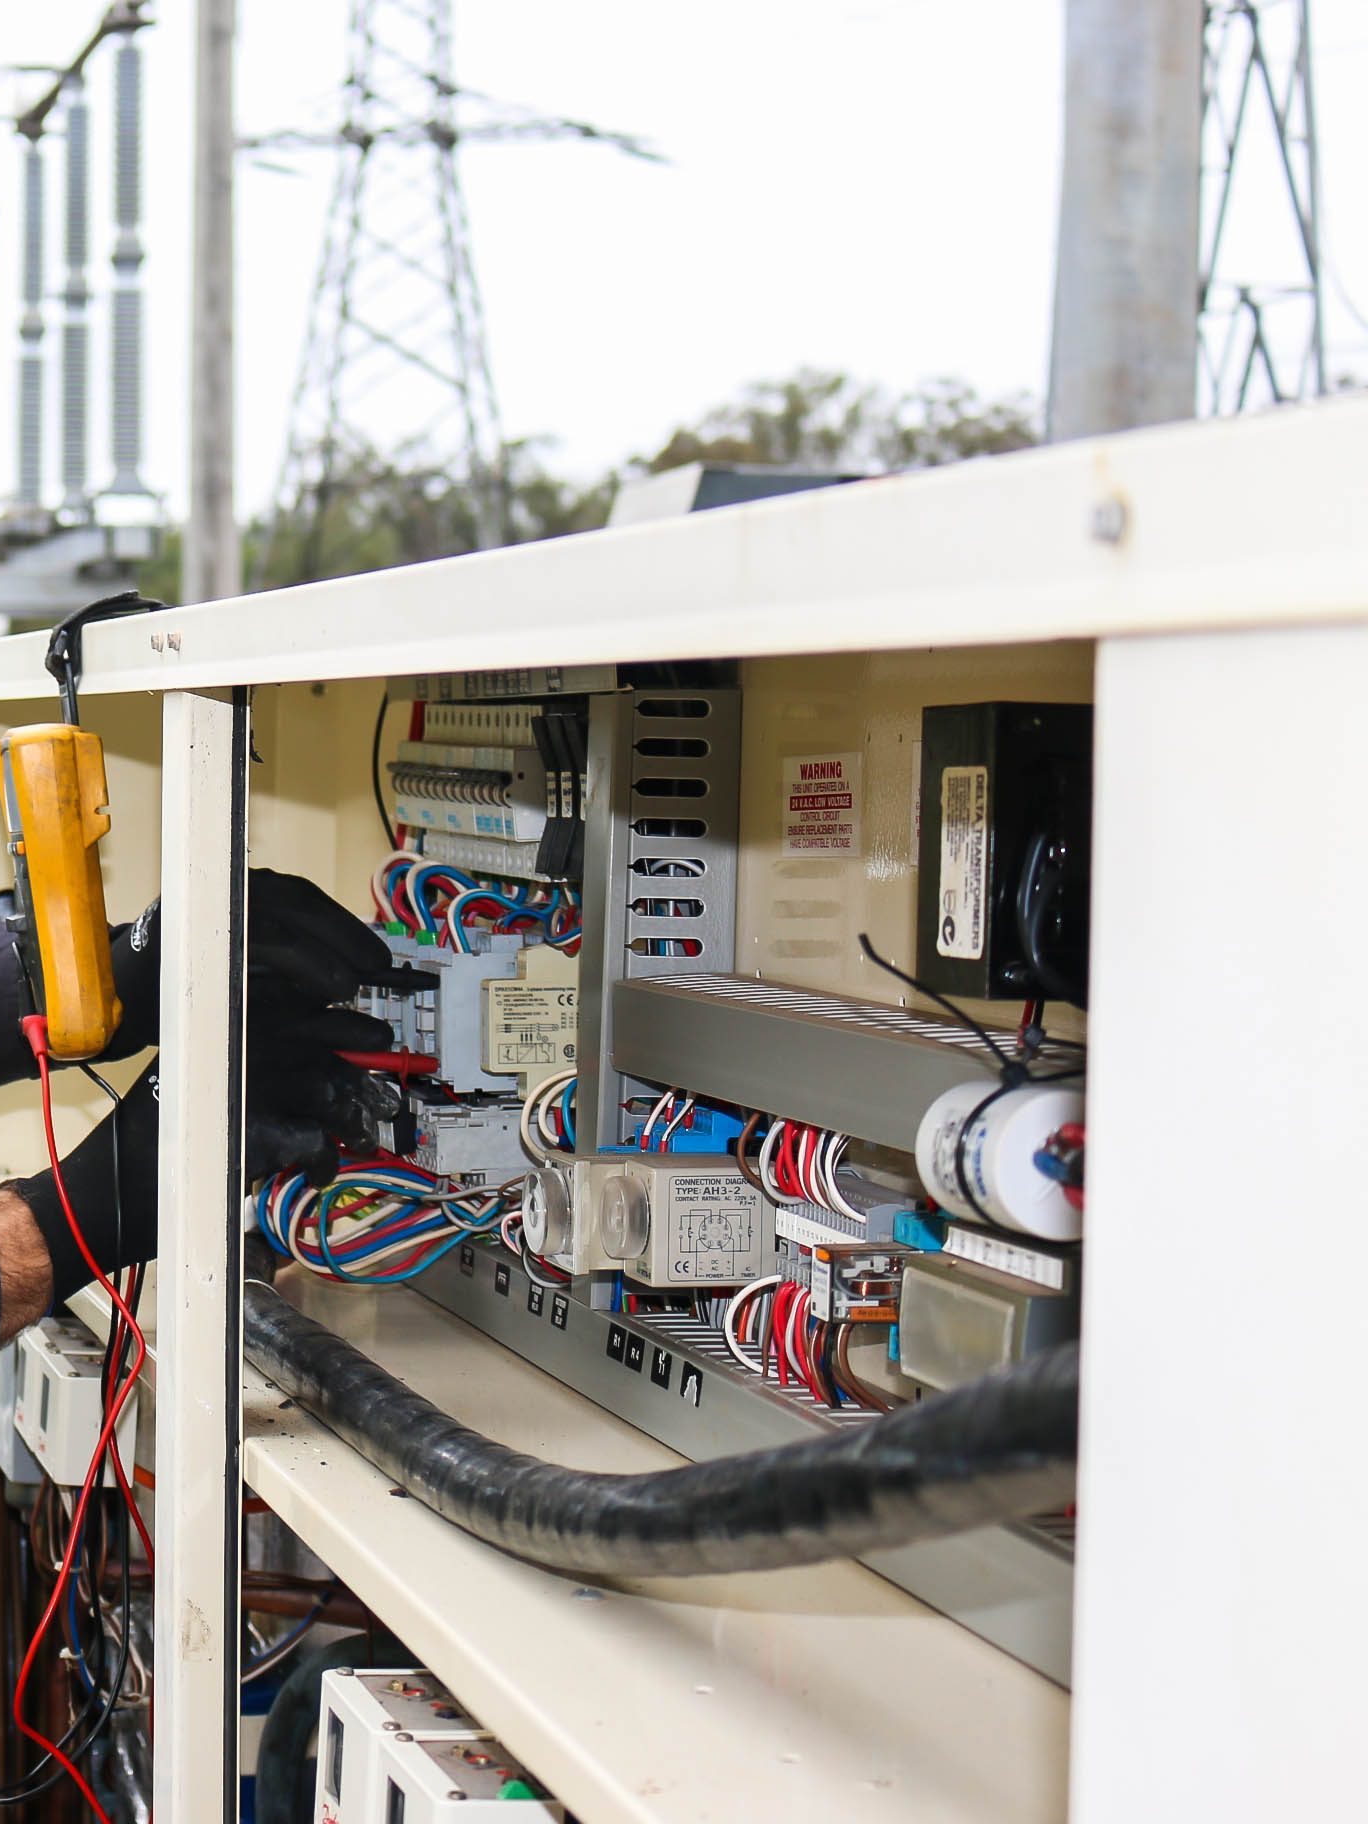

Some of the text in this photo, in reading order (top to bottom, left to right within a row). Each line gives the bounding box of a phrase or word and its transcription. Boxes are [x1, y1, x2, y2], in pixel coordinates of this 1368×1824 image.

[800, 761, 842, 780] WARNING
[792, 783, 801, 793] THIS
[802, 783, 812, 793] UNIT
[814, 782, 837, 792] OPERATES
[838, 781, 845, 792] ON
[815, 796, 826, 808] LOW
[828, 795, 850, 807] VOLTAGE
[800, 812, 821, 822] CONTROL
[806, 824, 837, 835] REPLACEMENT
[838, 824, 853, 834] PARTS
[830, 838, 850, 848] VOLTAGE
[972, 774, 984, 949] DELTA TRANSFORMERS
[675, 1177, 748, 1186] CONNECTION DIAGR
[675, 1260, 689, 1273] CE
[630, 1347, 640, 1361] R4
